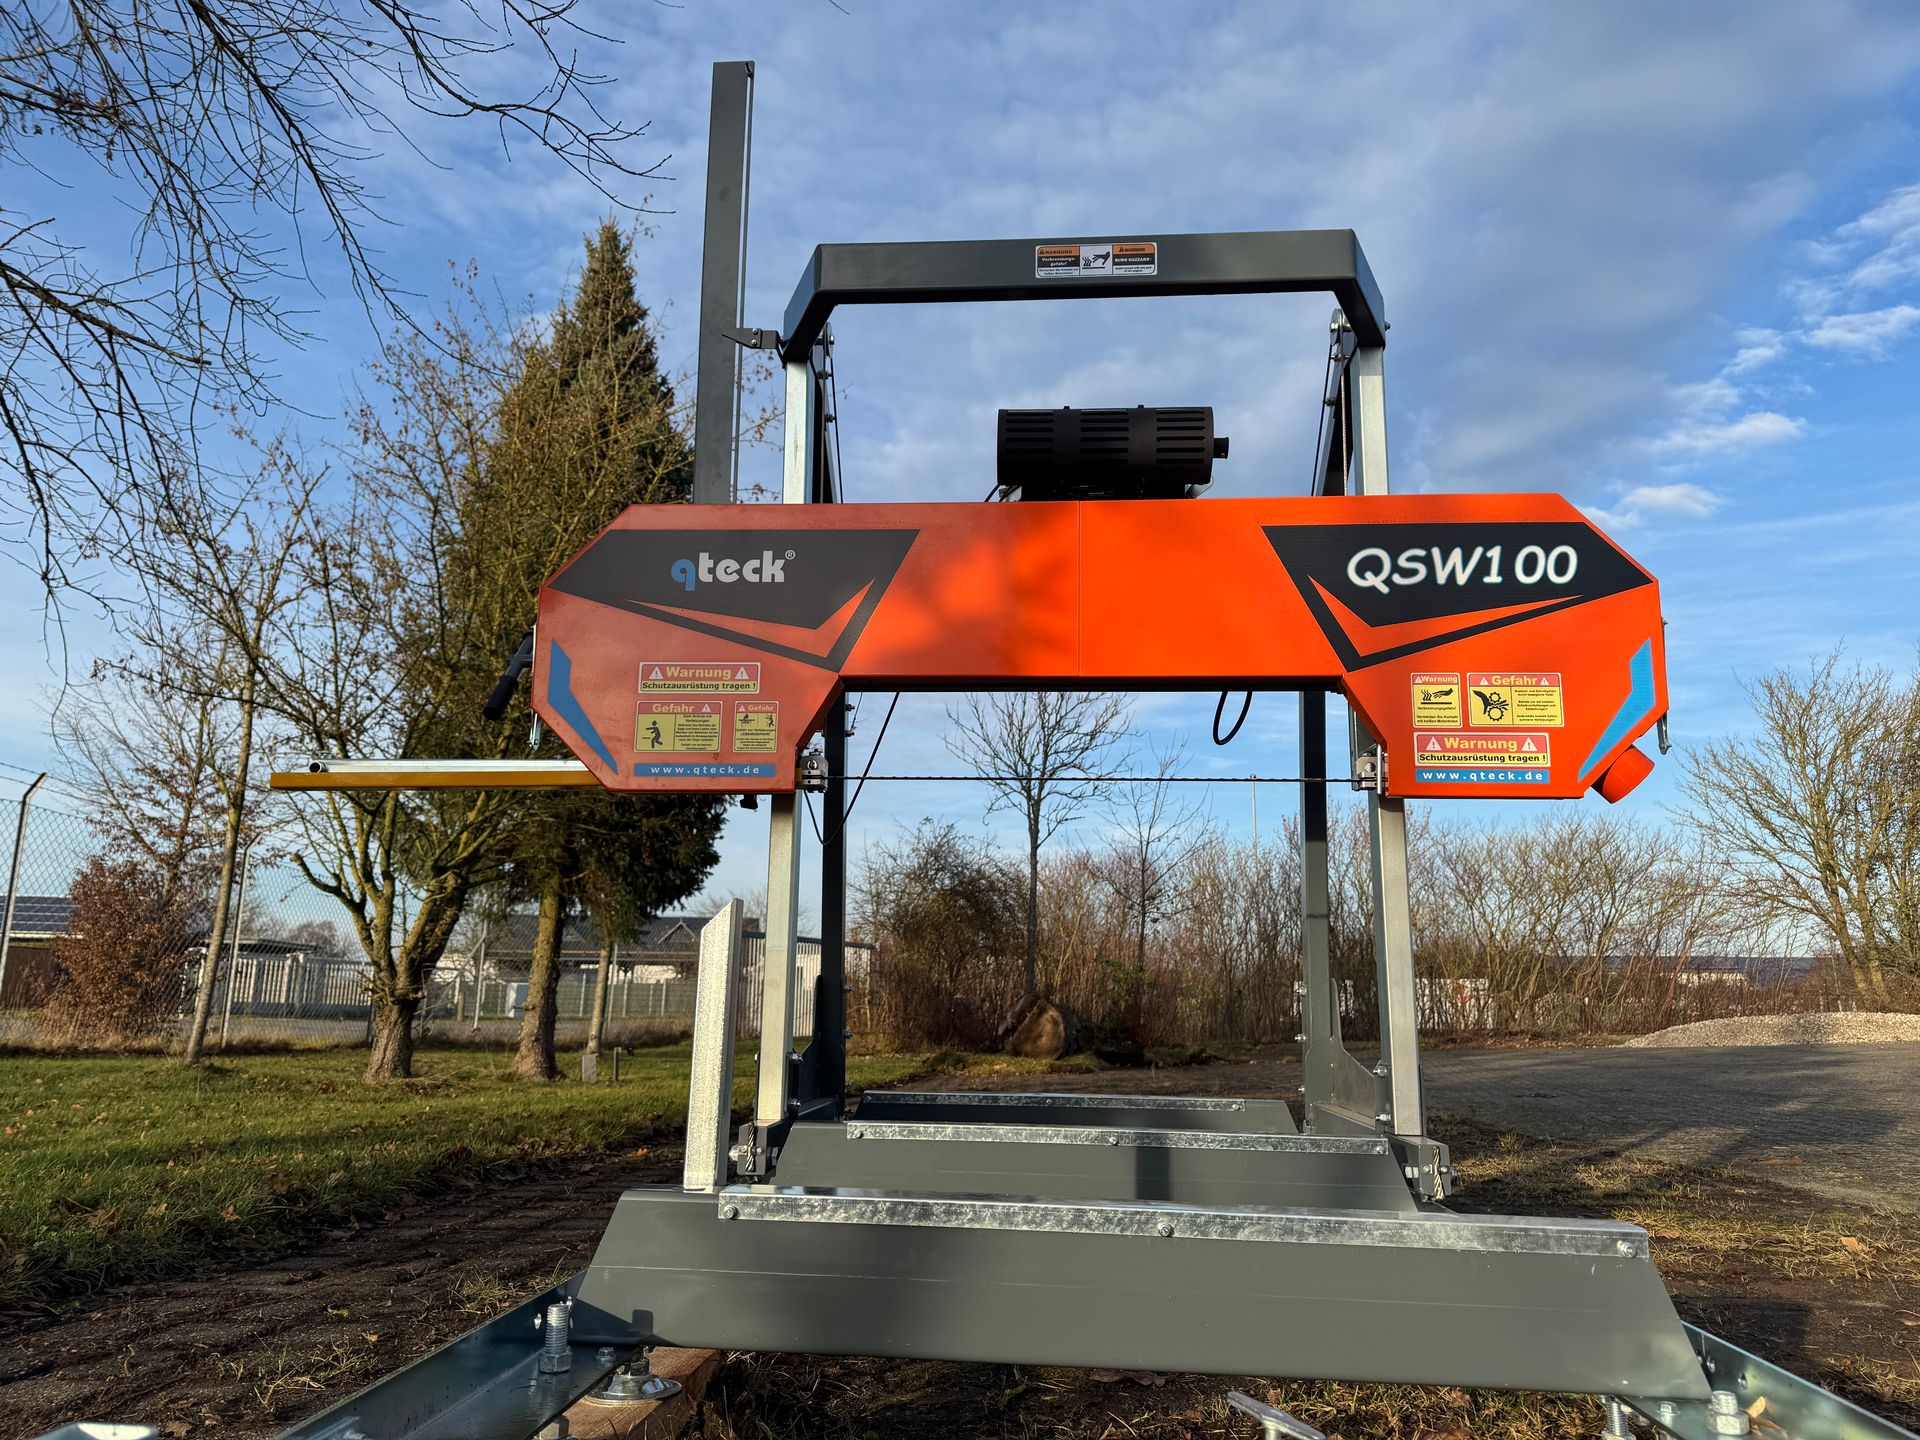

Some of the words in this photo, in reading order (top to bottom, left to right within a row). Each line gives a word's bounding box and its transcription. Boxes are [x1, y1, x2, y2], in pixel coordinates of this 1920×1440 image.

[1347, 545, 1577, 594] QSW100
[666, 666, 731, 679] Warnung
[1492, 676, 1537, 685] Gefahr
[642, 682, 720, 690] Schutzausrüstung
[652, 704, 695, 712] Gefahr
[1444, 737, 1517, 751] Warnung
[1419, 754, 1506, 763] Schutzausrüstung
[1508, 754, 1540, 763] tragen
[651, 766, 760, 775] www.qteck.de
[1423, 771, 1543, 781] www.qteck.de
